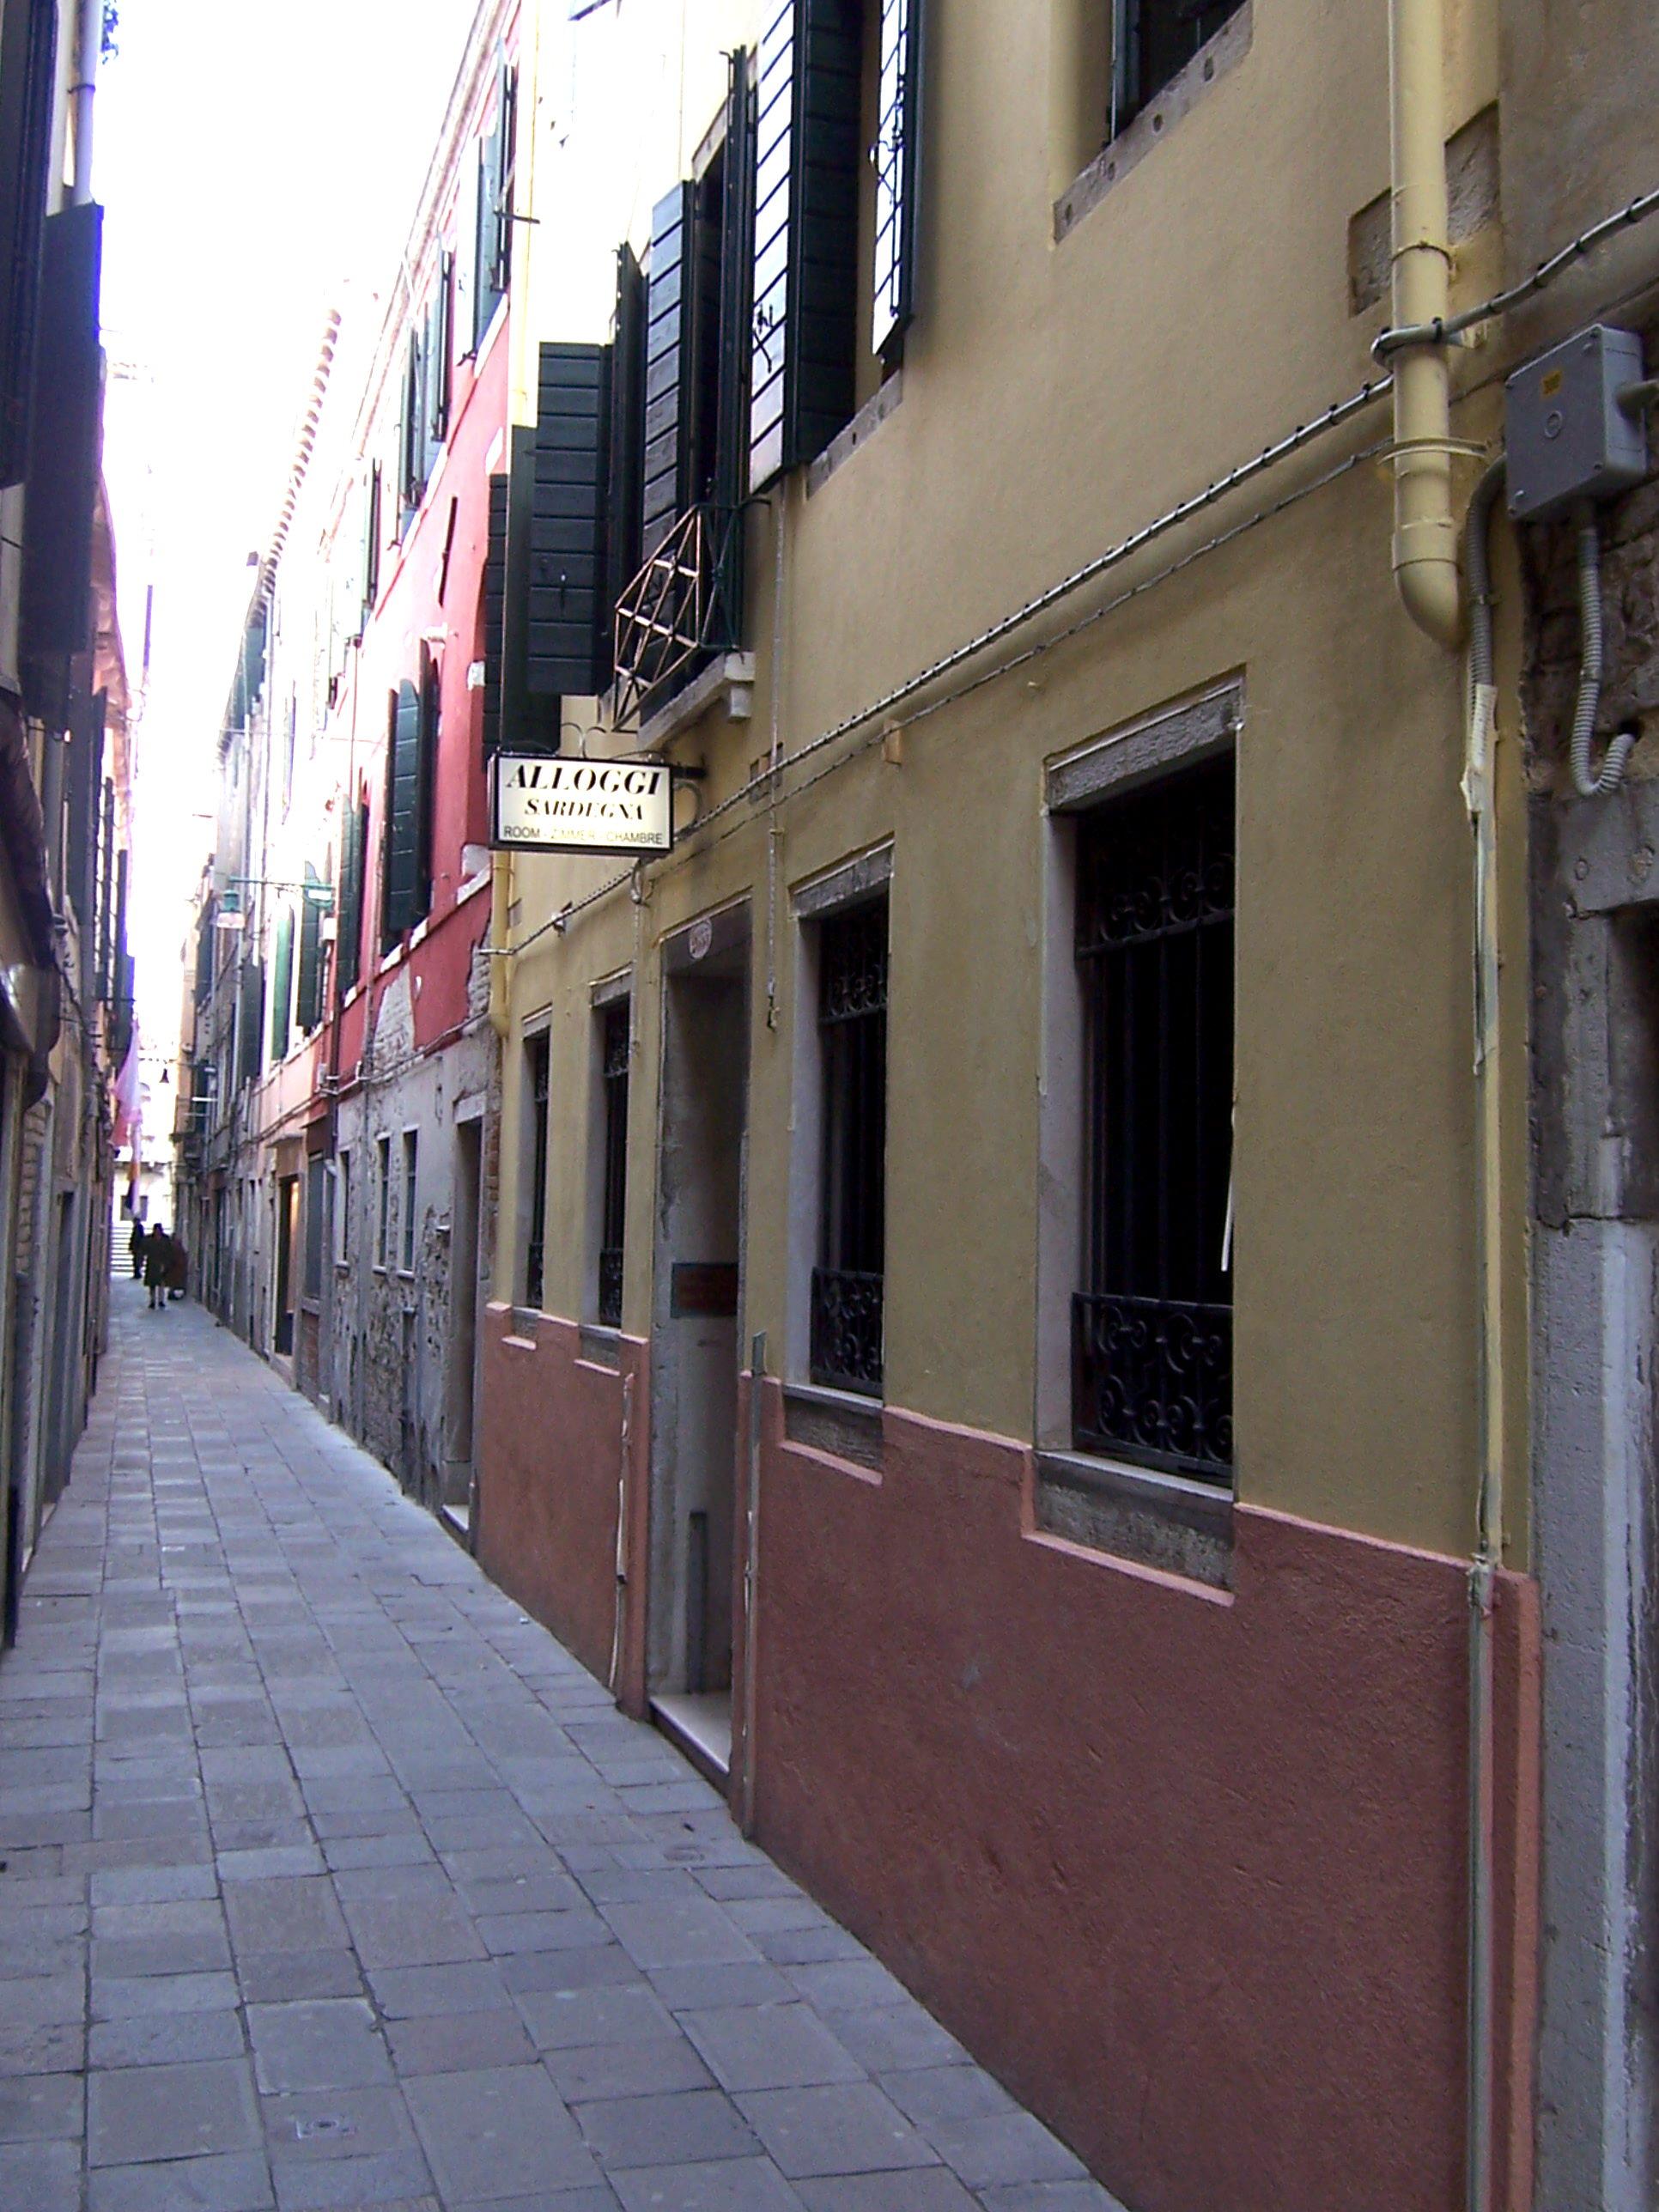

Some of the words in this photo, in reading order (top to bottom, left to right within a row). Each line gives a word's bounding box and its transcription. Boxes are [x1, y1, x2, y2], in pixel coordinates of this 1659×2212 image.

[506, 764, 660, 795] ALLOGGI
[524, 798, 642, 820] SARDEGNA
[503, 825, 540, 839] ROOM
[606, 830, 663, 845] CHAMBRE
